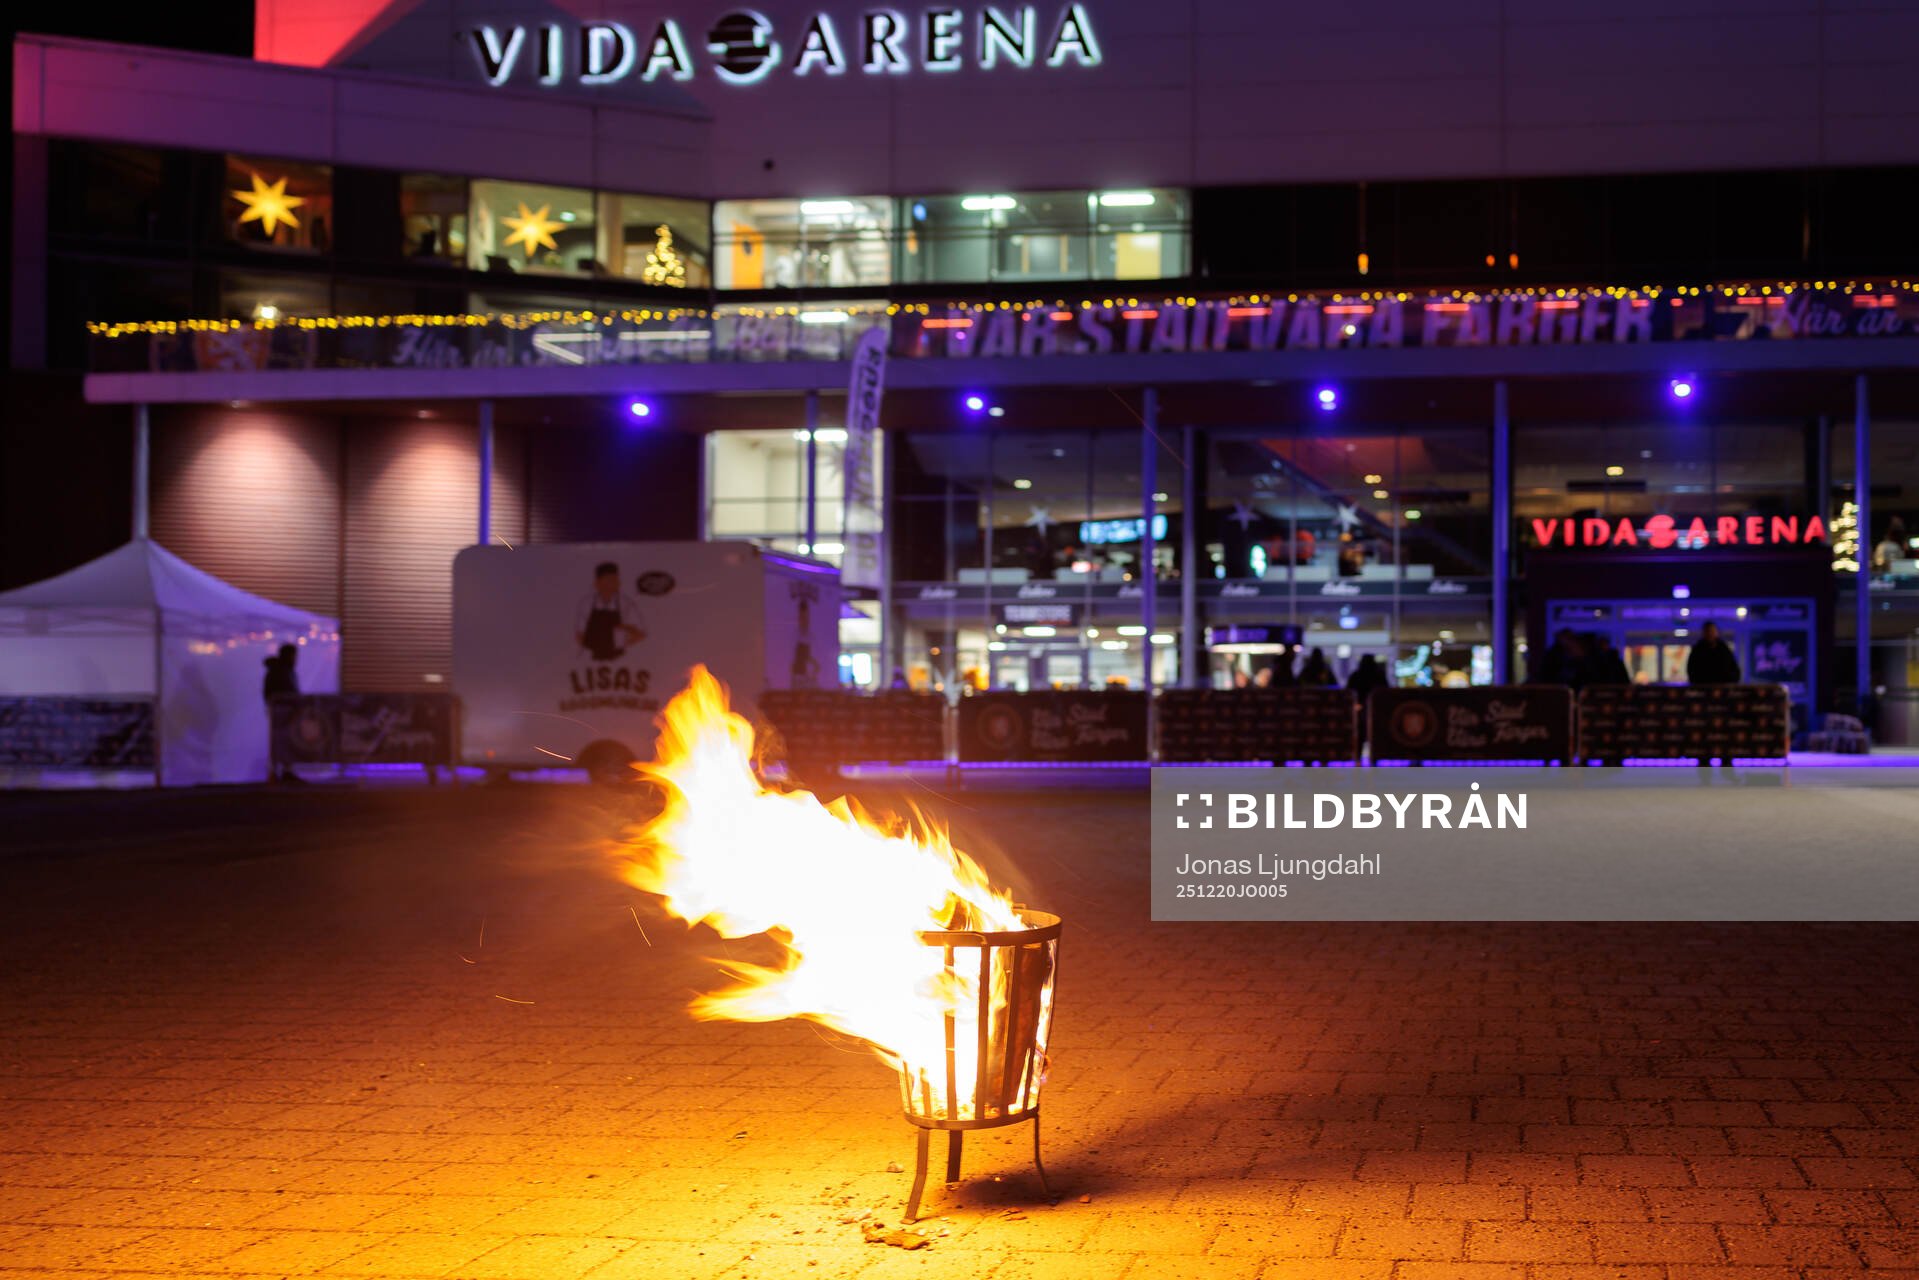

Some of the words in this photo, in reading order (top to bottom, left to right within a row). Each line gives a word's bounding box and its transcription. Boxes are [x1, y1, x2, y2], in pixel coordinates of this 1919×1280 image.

[471, 19, 694, 86] VIDA
[793, 4, 1103, 76] ARENA
[1532, 517, 1638, 547] VIDA
[1688, 514, 1826, 546] ARENA
[569, 666, 650, 694] LISAS
